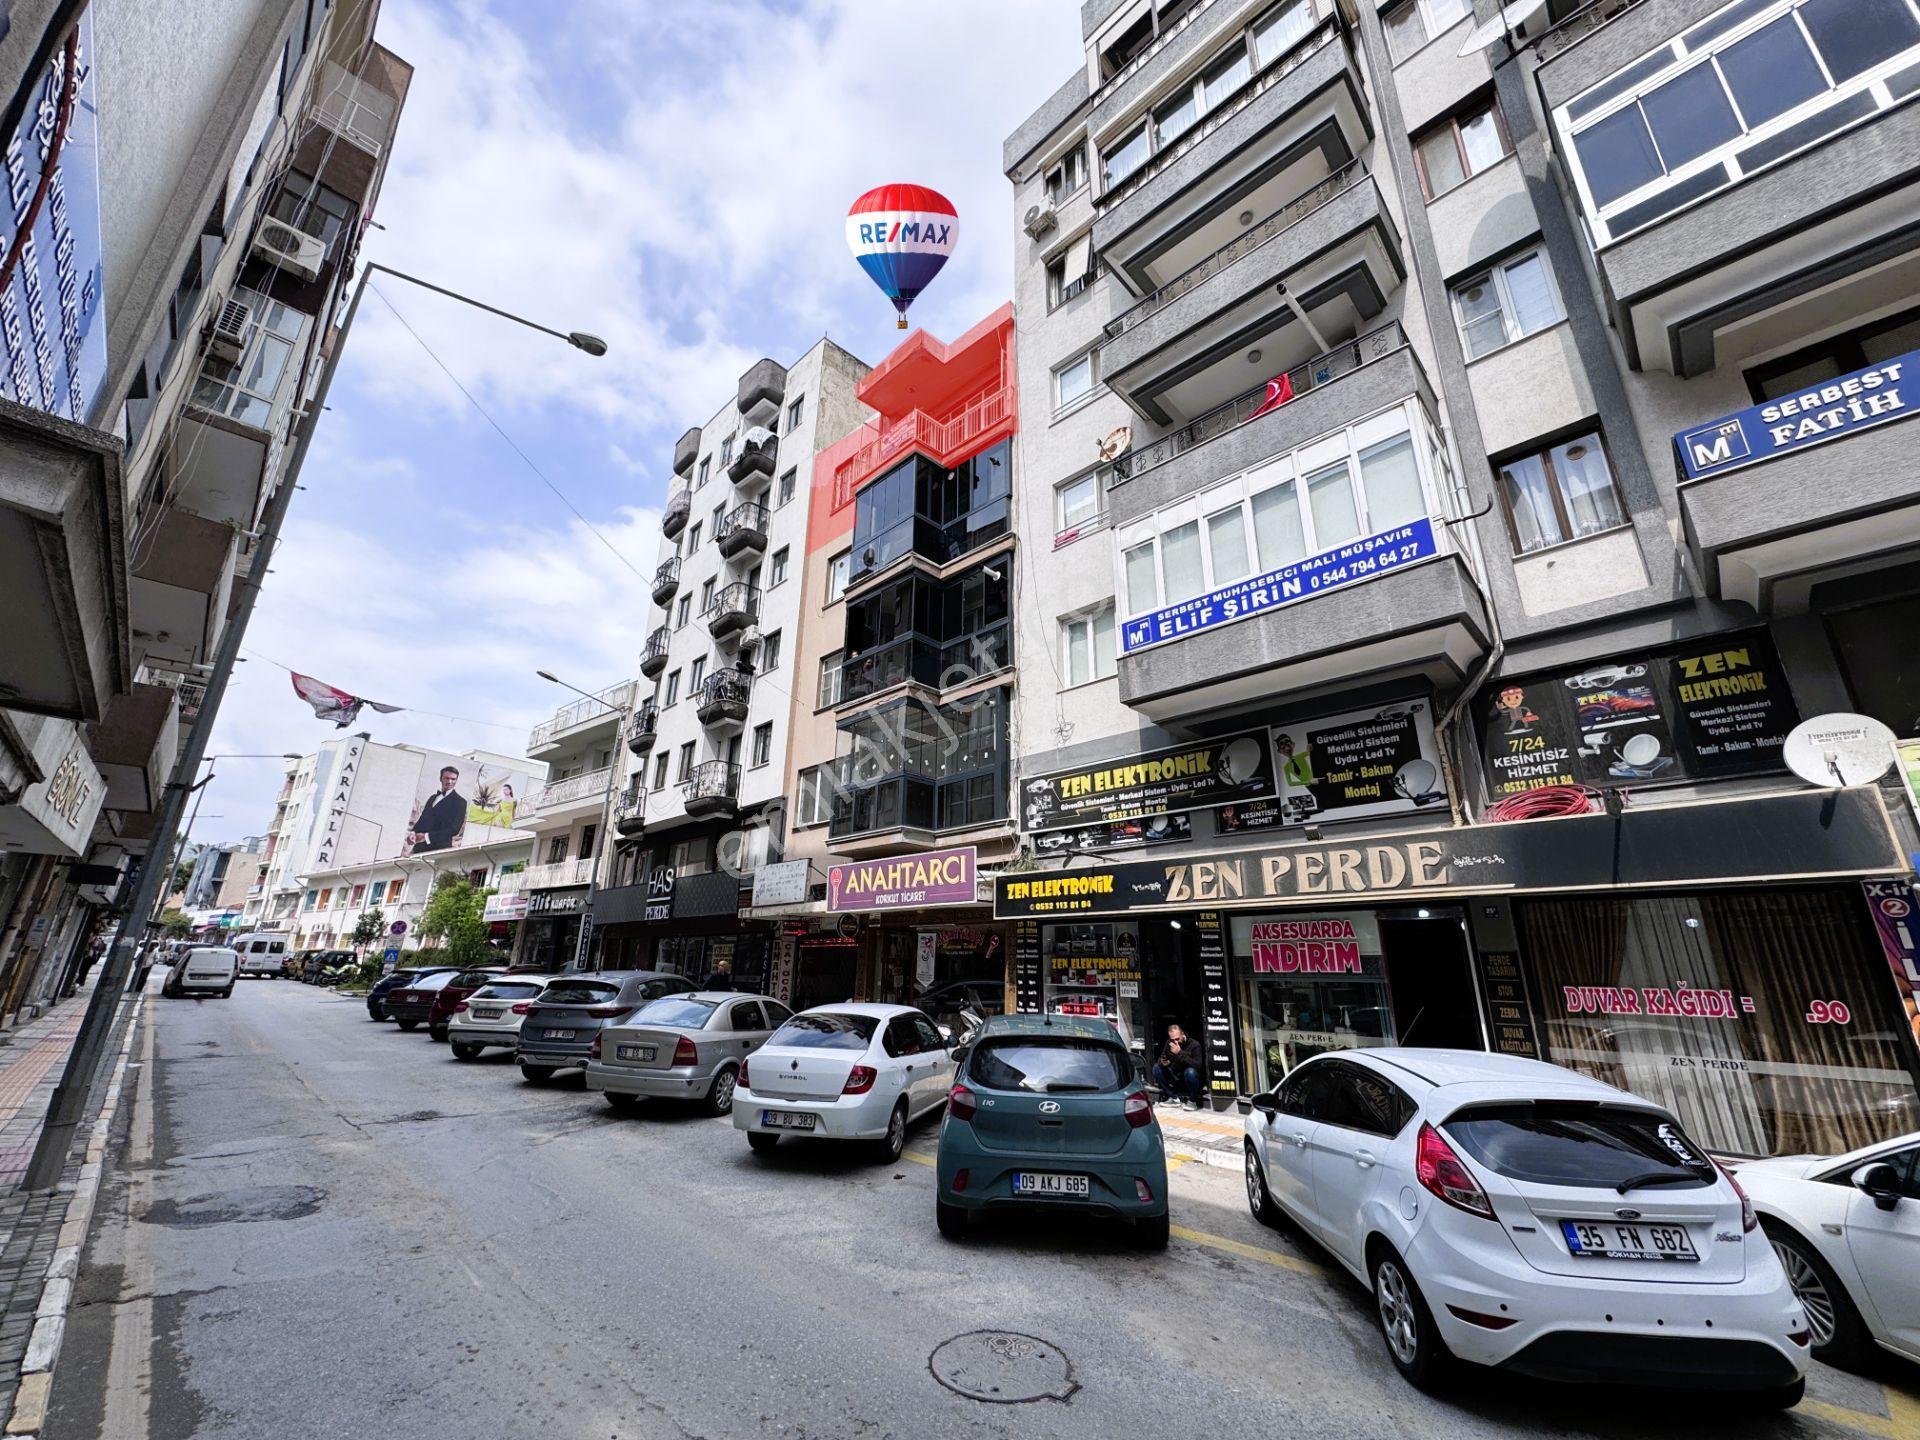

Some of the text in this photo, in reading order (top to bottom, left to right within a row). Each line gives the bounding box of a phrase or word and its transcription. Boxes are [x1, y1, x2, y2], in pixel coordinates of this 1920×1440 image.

[50, 166, 68, 239] AYDIN
[1761, 363, 1902, 424] SERBEST
[1769, 388, 1905, 447] FATİH
[1157, 597, 1210, 621] SERBEST
[1212, 566, 1298, 603] MUHASEBECI
[1301, 553, 1337, 572] MALI
[1159, 542, 1419, 638] ELİF ŞİRİN 0 544 794 64 27
[1678, 648, 1751, 679] ZEN
[1678, 671, 1767, 703] ELEKTRONİK
[1689, 699, 1771, 719] Güvenlik Sistemleri
[1700, 709, 1766, 728] Merkezi Sistem
[1316, 719, 1408, 746] Güvenlik Sistemleri
[1708, 721, 1763, 737] Uydu Led Tv
[1327, 734, 1400, 755] Merkezi Sistem
[1509, 736, 1545, 753] 7/24
[1696, 743, 1719, 756] Tamir
[1724, 739, 1750, 753] Bakım
[1334, 747, 1396, 766] Uydu Led Tv
[1493, 747, 1570, 769] KESİNTİSİZ
[1060, 751, 1212, 799] ZEN ELEKTRONİK
[1326, 763, 1393, 784] Tamir Bakım
[1507, 762, 1559, 779] HİZMET
[1118, 789, 1144, 801] Merkezi
[1144, 786, 1167, 798] Sistem
[1171, 782, 1188, 793] Uydu
[1344, 783, 1380, 799] Montaj
[1503, 774, 1573, 793] 0532 113 81 84
[318, 746, 358, 864] SARANLAR
[1108, 810, 1127, 820] 0532
[1249, 801, 1267, 811] 7/24
[1247, 816, 1273, 826] HİZMET
[647, 868, 674, 894] HAS
[845, 854, 968, 895] ANAHTARCI
[1164, 840, 1448, 902] ZEN PERDE
[1006, 882, 1030, 900] ZEN
[1031, 874, 1114, 898] ELEKTRONİK
[875, 890, 926, 905] KORKUT TİCARET
[1035, 901, 1054, 911] 0532
[1055, 900, 1068, 910] 113
[1887, 901, 1904, 914] 2
[645, 904, 670, 920] PERDE
[1251, 920, 1356, 942] AKSESUARDA
[1052, 957, 1129, 970] ZEN ELEKTRONİK
[1252, 940, 1363, 974] İNDİRİM
[1563, 980, 1851, 1025] DUVAR KAĞIDI = .90
[1499, 1007, 1521, 1019] ZEBRA
[1670, 1056, 1749, 1071] ZEN PERDE
[767, 1112, 778, 1124] 09
[798, 1114, 813, 1126] 383
[1021, 1175, 1087, 1192] 09 AKJ 685
[1577, 1225, 1690, 1252] 35 FN 682
